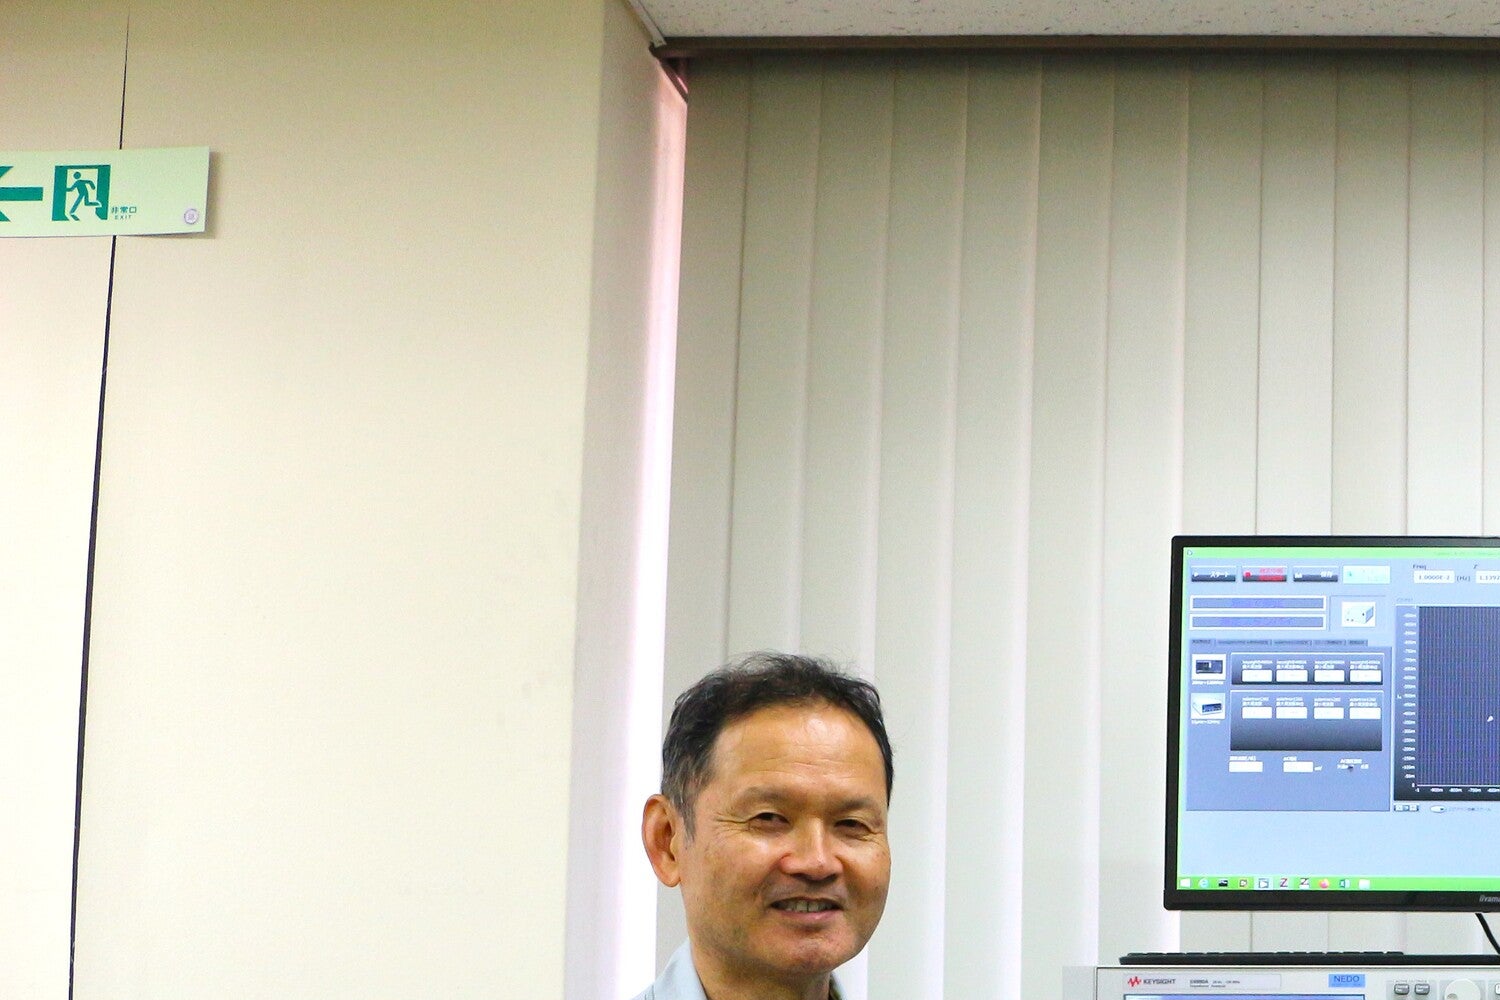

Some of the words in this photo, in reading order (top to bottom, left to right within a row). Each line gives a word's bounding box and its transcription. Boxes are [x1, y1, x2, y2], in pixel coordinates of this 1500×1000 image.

[111, 206, 137, 214] 非常口
[1334, 975, 1360, 983] NEDO
